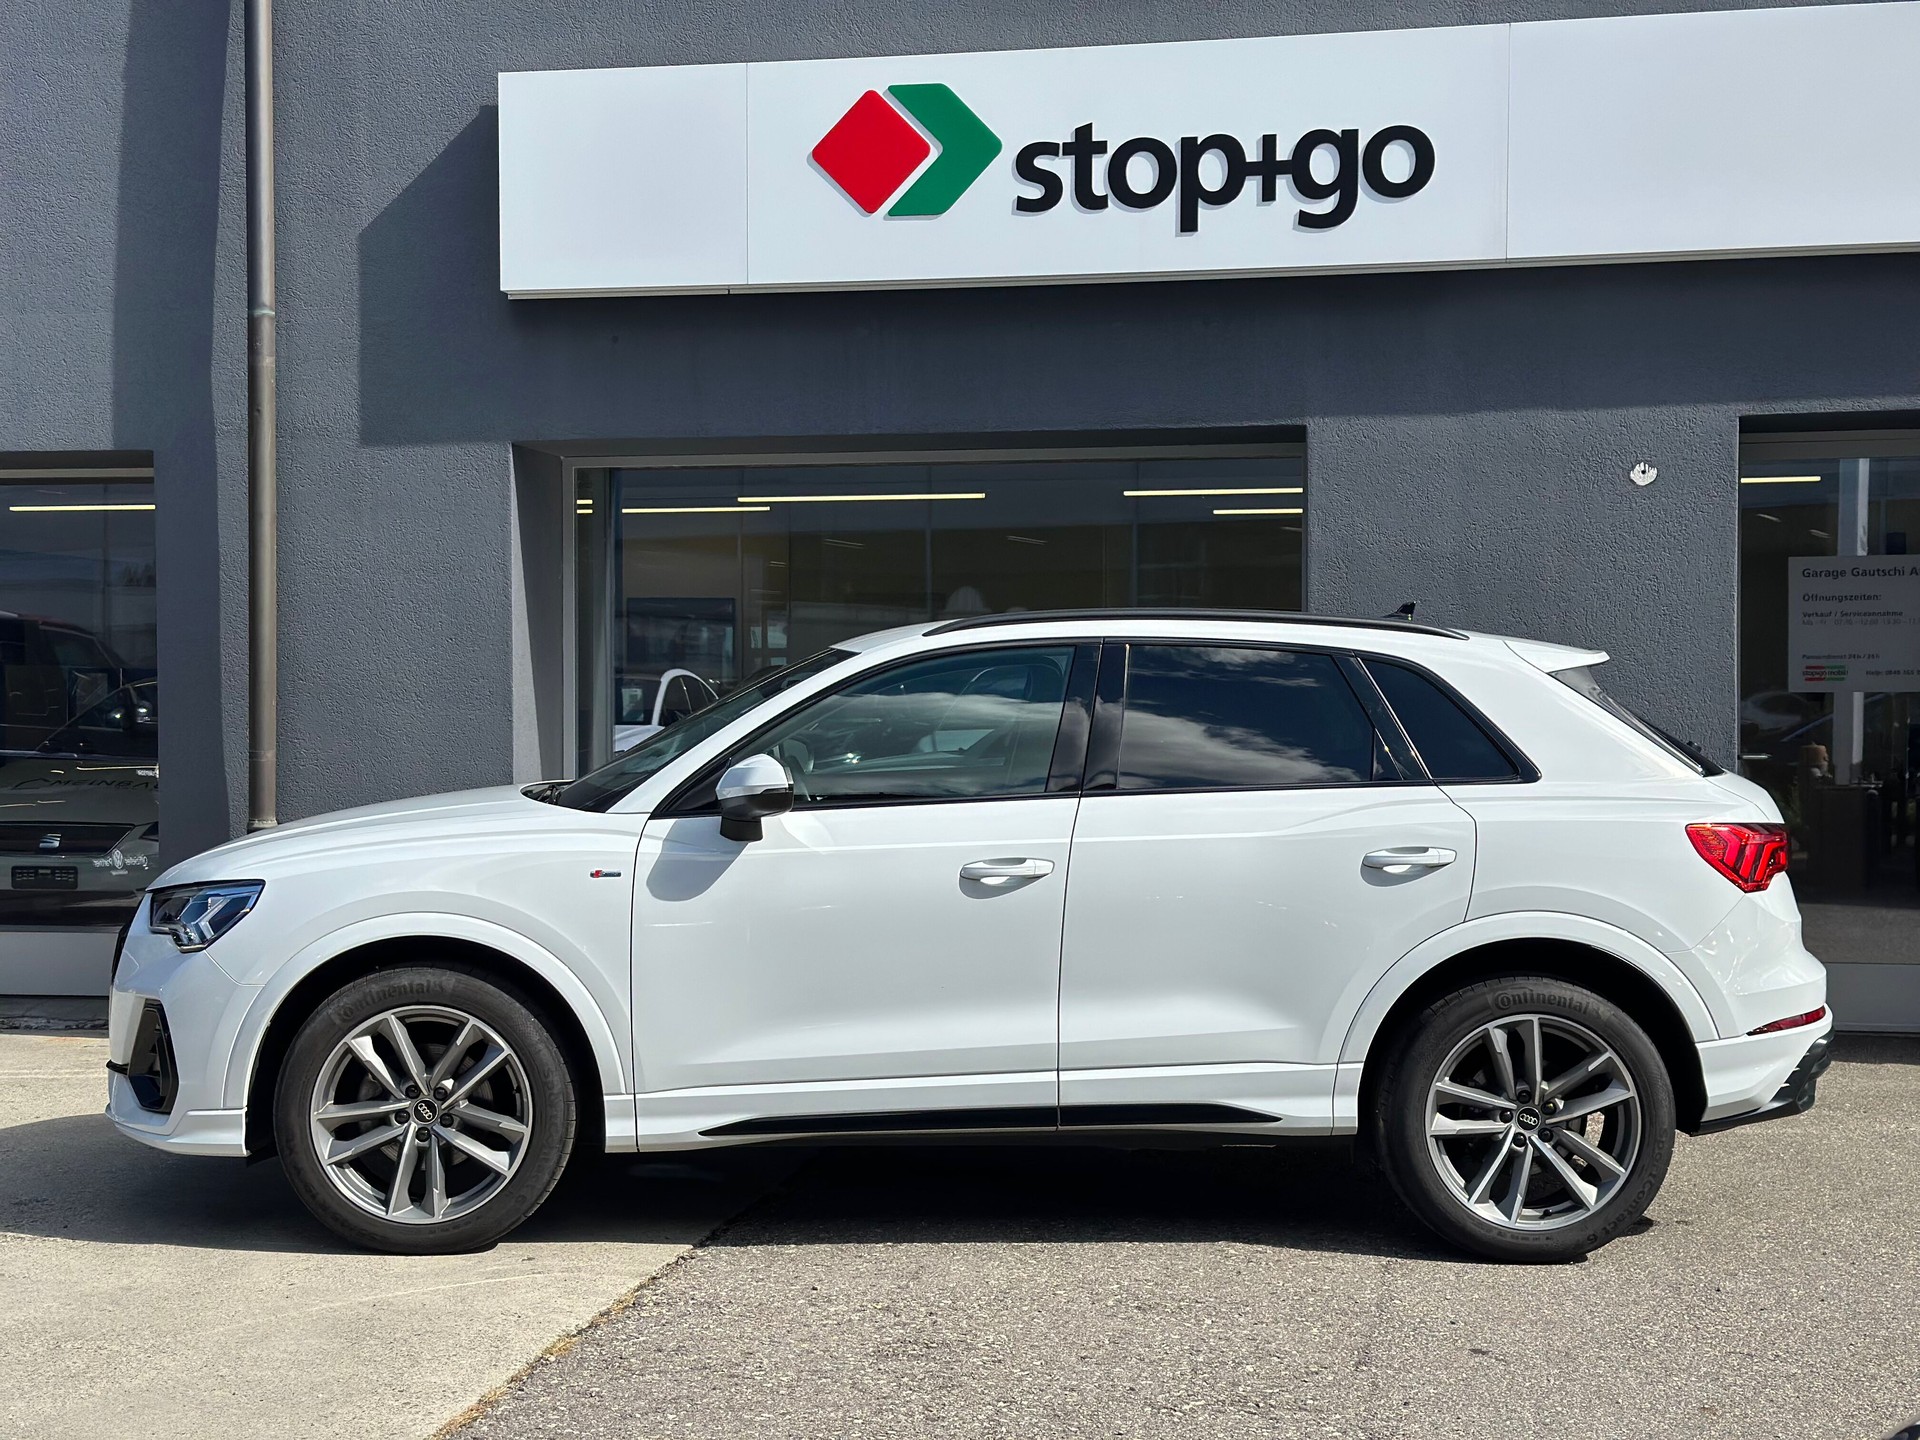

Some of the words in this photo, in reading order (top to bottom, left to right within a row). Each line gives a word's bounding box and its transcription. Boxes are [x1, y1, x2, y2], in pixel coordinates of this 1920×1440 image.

[1016, 123, 1434, 232] stop+go
[1802, 568, 1847, 579] Garage
[1851, 566, 1905, 577] Gautschi
[1909, 567, 1920, 577] A
[1494, 991, 1591, 1016] Continental
